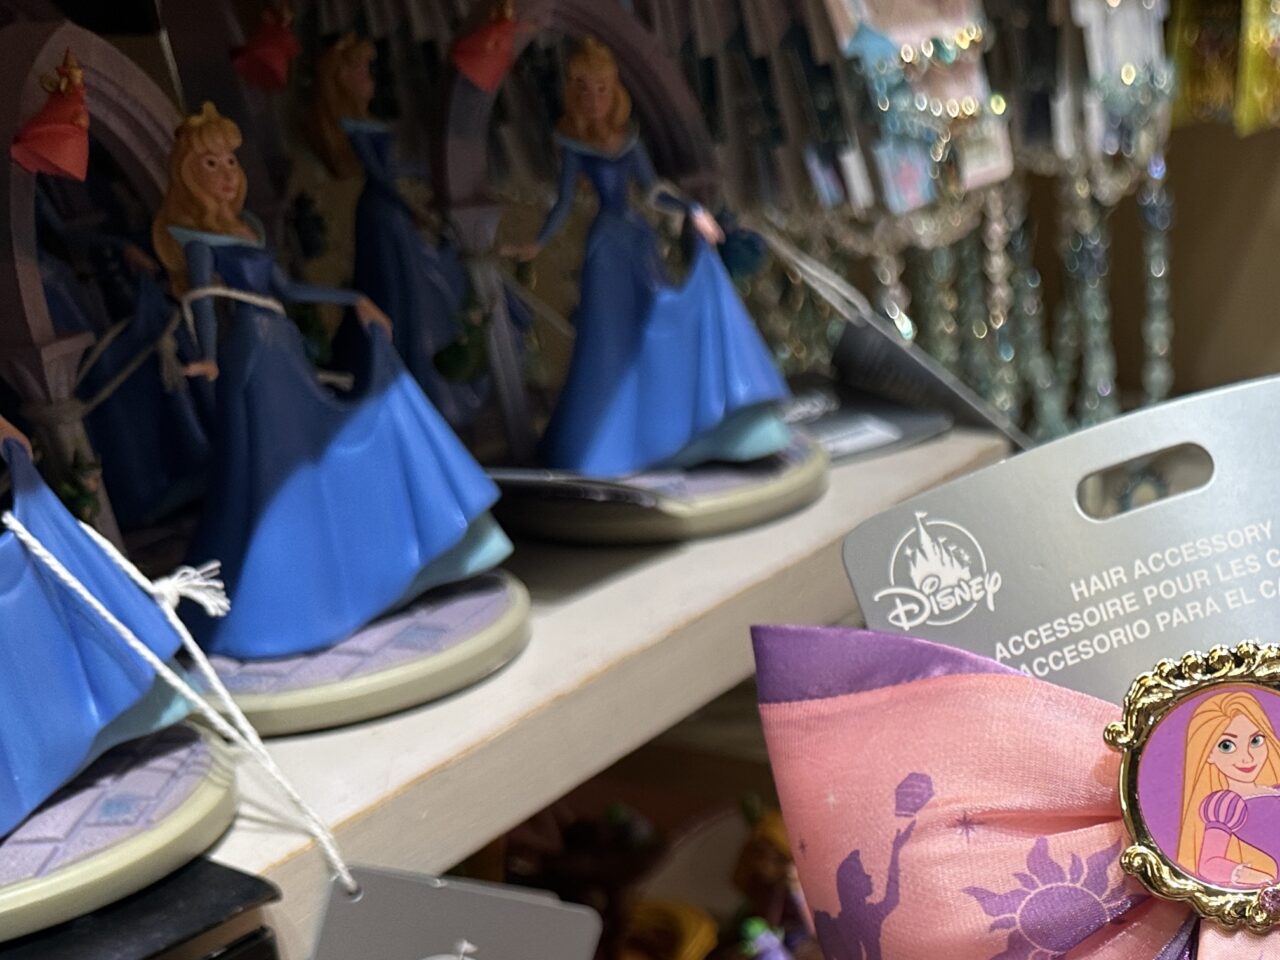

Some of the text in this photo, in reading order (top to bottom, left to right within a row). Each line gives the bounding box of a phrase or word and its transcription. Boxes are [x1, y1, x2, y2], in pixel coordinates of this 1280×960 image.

[1070, 520, 1273, 602] HAIR ACCESSORY
[994, 592, 1140, 662] ACCESSOIRE
[1143, 569, 1211, 605] POUR
[1215, 554, 1261, 582] LES
[1020, 619, 1151, 677] ACCESORIO
[1155, 597, 1222, 632] PARA
[1224, 587, 1255, 611] EL
